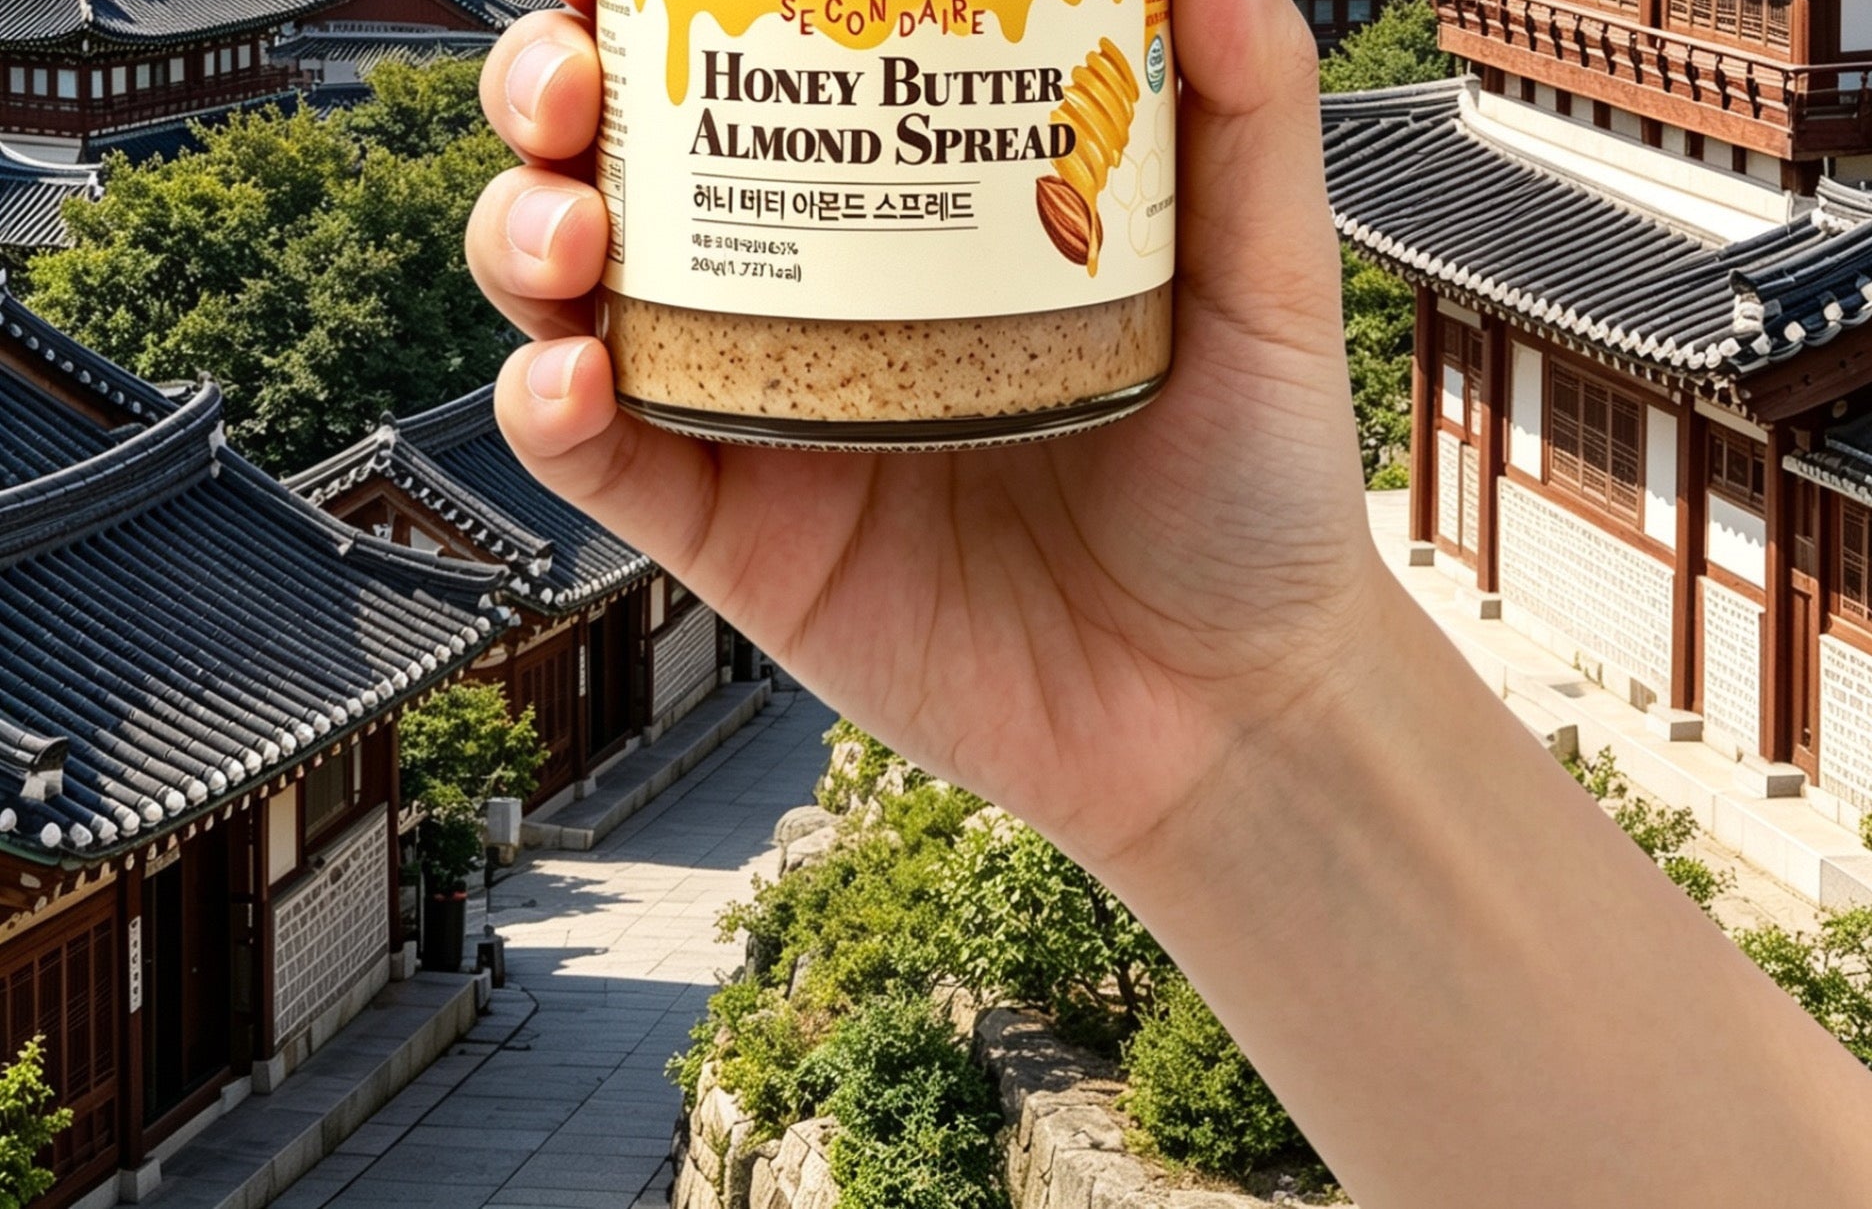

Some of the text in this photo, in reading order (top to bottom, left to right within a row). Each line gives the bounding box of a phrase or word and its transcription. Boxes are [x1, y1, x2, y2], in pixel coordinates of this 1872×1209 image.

[700, 50, 1065, 107] HONEY BUTTER
[689, 107, 883, 165] ALMOND
[895, 112, 1076, 166] SPREAD
[792, 190, 868, 222] 아몬드
[872, 191, 975, 222] 스프레드
